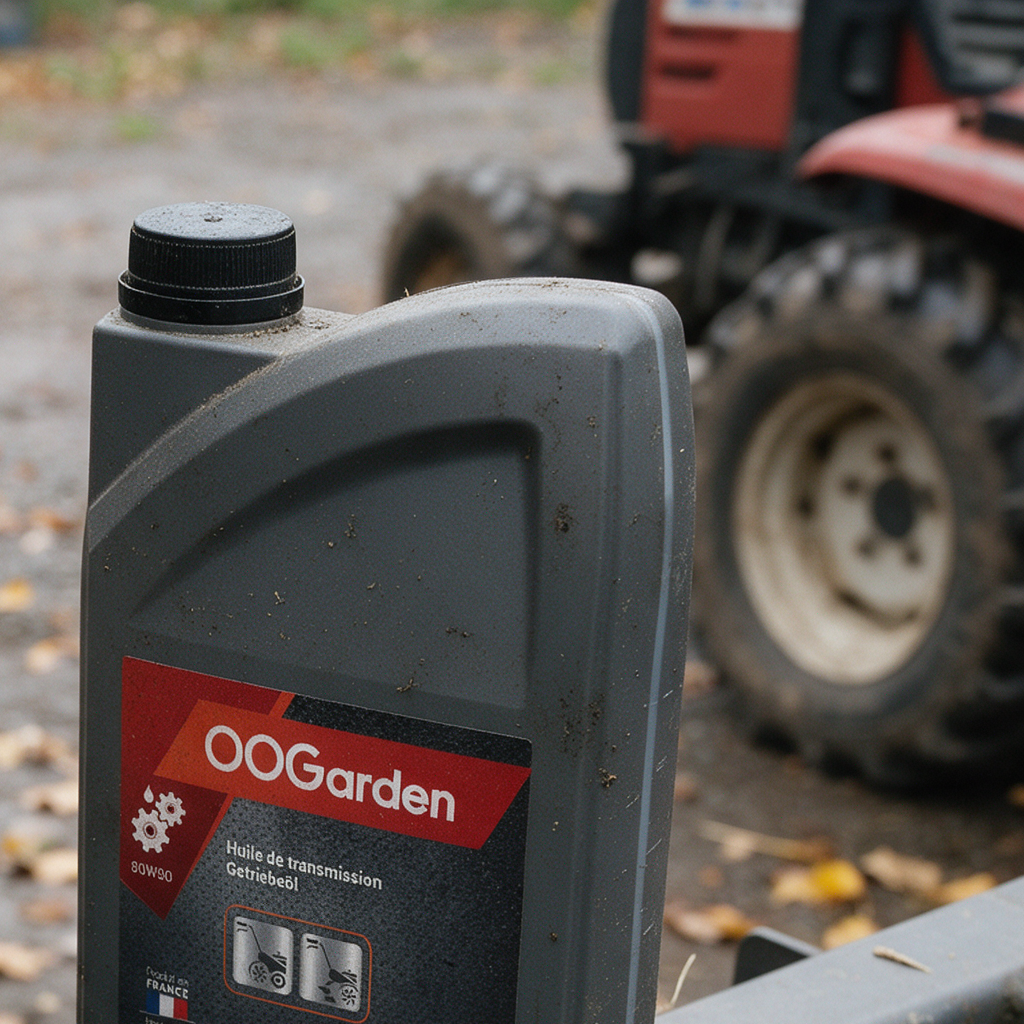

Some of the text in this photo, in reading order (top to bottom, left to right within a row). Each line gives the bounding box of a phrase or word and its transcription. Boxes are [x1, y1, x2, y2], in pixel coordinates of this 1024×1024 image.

[204, 724, 456, 823] OOGarden
[130, 860, 173, 883] 80W90
[226, 839, 383, 891] Huile de transmission
[226, 861, 299, 892] Getriebeöl
[146, 978, 189, 1000] FRANCE
